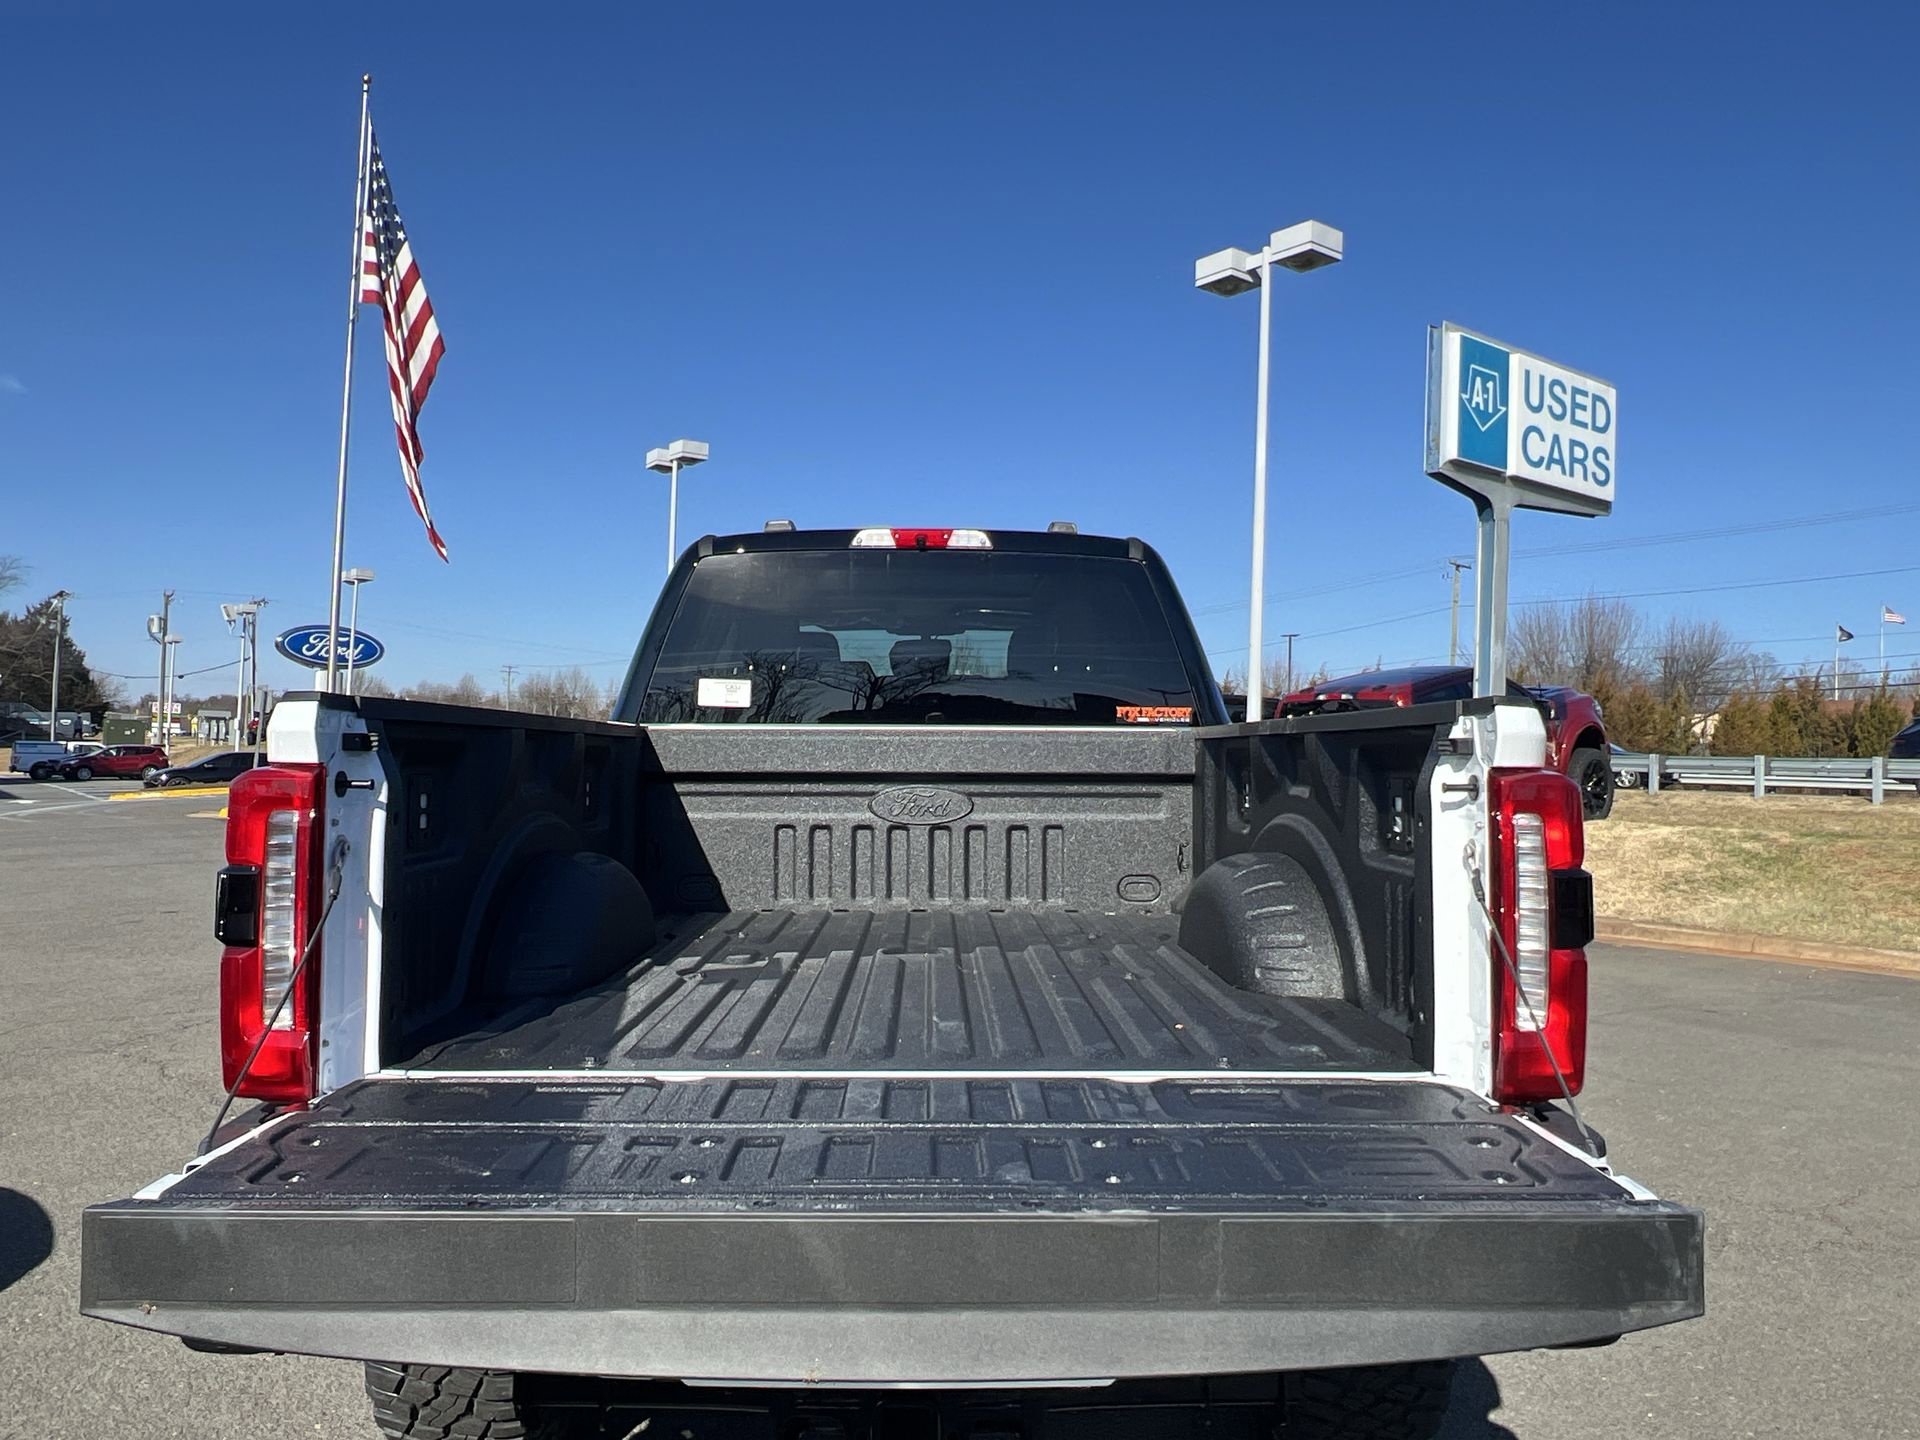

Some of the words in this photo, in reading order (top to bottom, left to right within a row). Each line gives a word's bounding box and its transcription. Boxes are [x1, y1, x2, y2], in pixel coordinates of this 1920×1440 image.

[1472, 377, 1494, 414] A-1
[1524, 370, 1611, 434] USED
[1522, 426, 1610, 487] CARS
[302, 633, 364, 660] Ford
[1141, 706, 1193, 717] FACTORY
[889, 790, 952, 817] Ford
